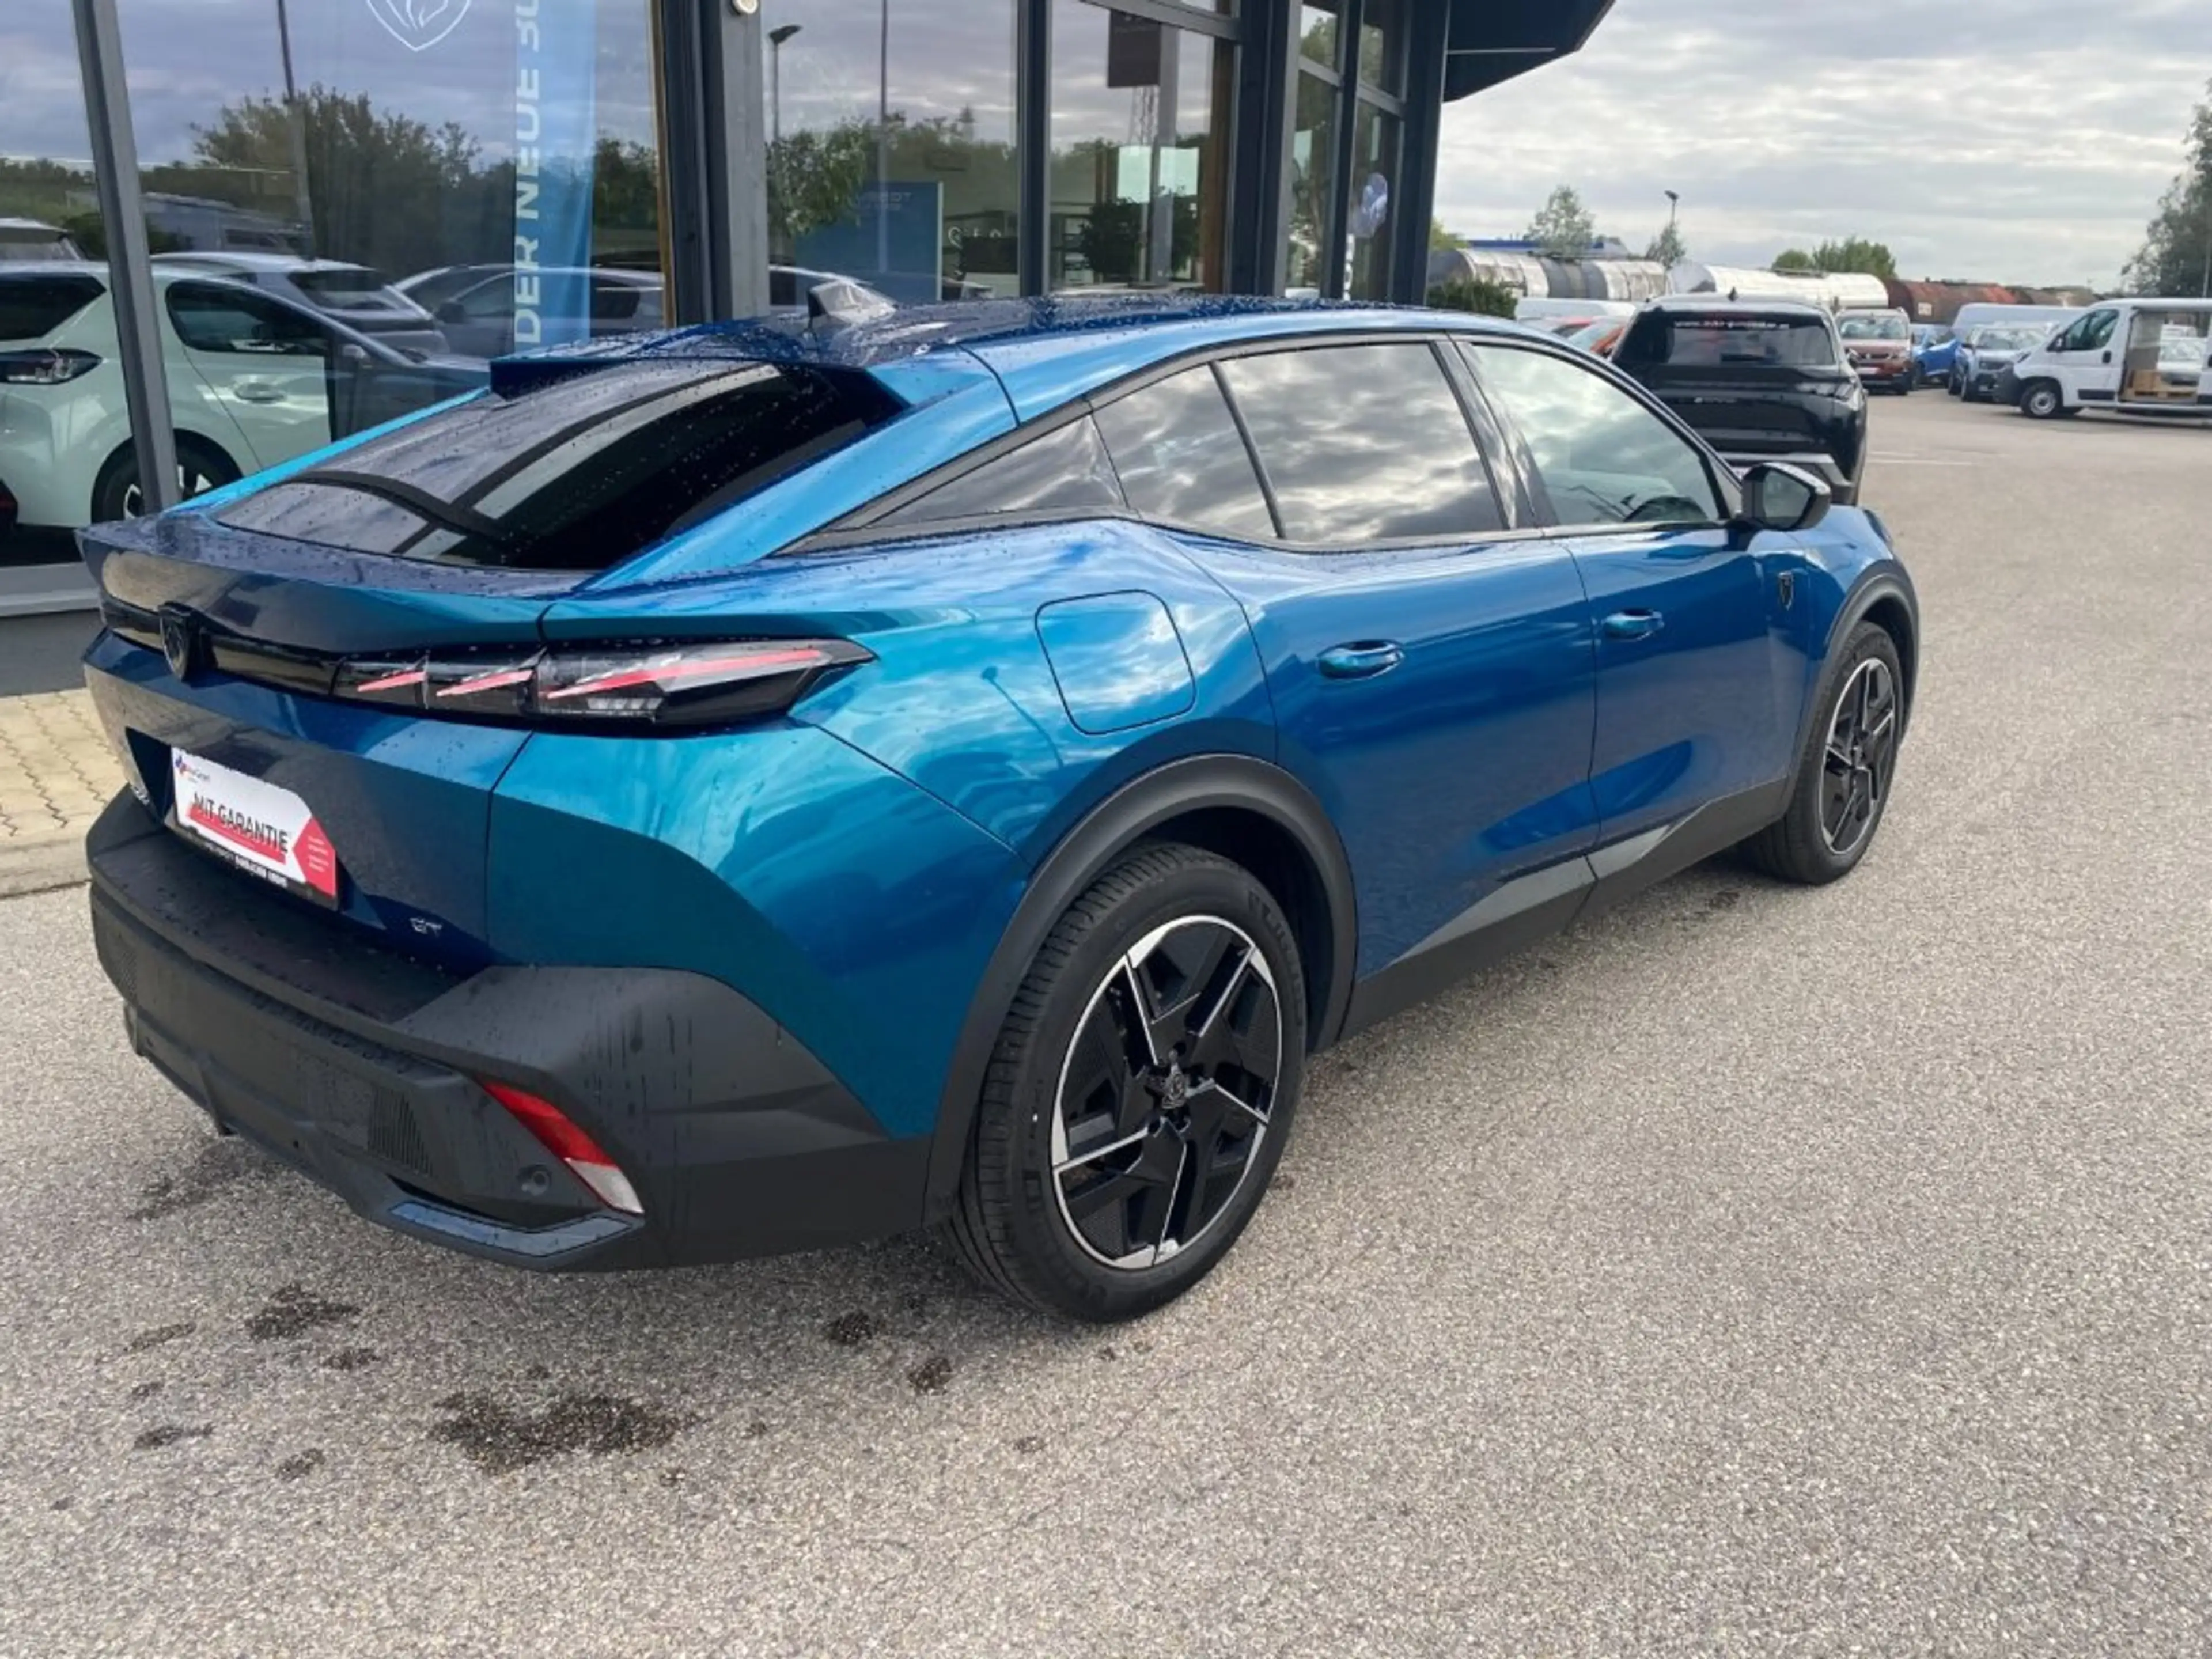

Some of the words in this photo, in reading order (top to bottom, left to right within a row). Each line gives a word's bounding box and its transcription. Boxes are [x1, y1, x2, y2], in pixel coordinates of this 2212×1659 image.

[515, 69, 540, 221] NEUE
[514, 235, 540, 344] DER
[193, 791, 215, 819] MIT
[218, 804, 289, 853] GARANTIE
